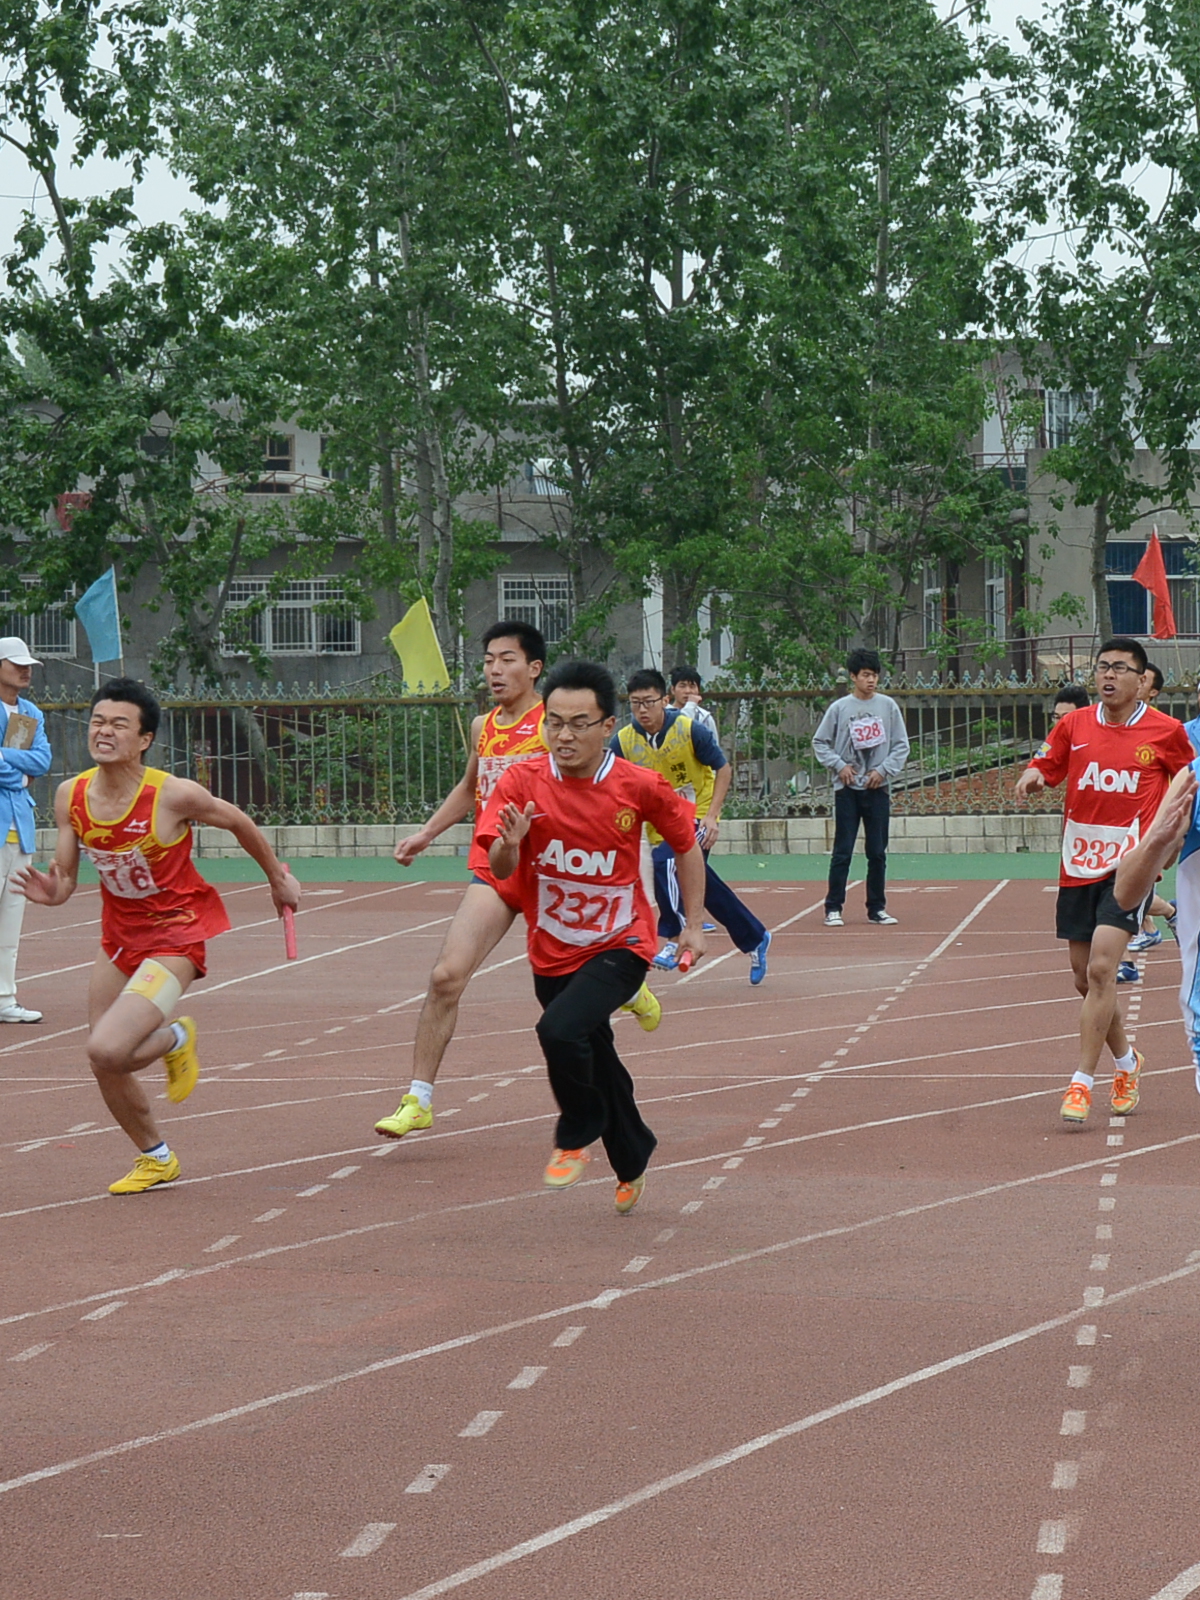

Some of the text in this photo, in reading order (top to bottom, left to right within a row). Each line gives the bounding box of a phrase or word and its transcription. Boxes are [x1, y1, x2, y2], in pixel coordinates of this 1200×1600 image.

[854, 722, 881, 742] 328
[1077, 761, 1141, 793] AON
[537, 839, 617, 876] AON
[544, 883, 623, 932] 2321
